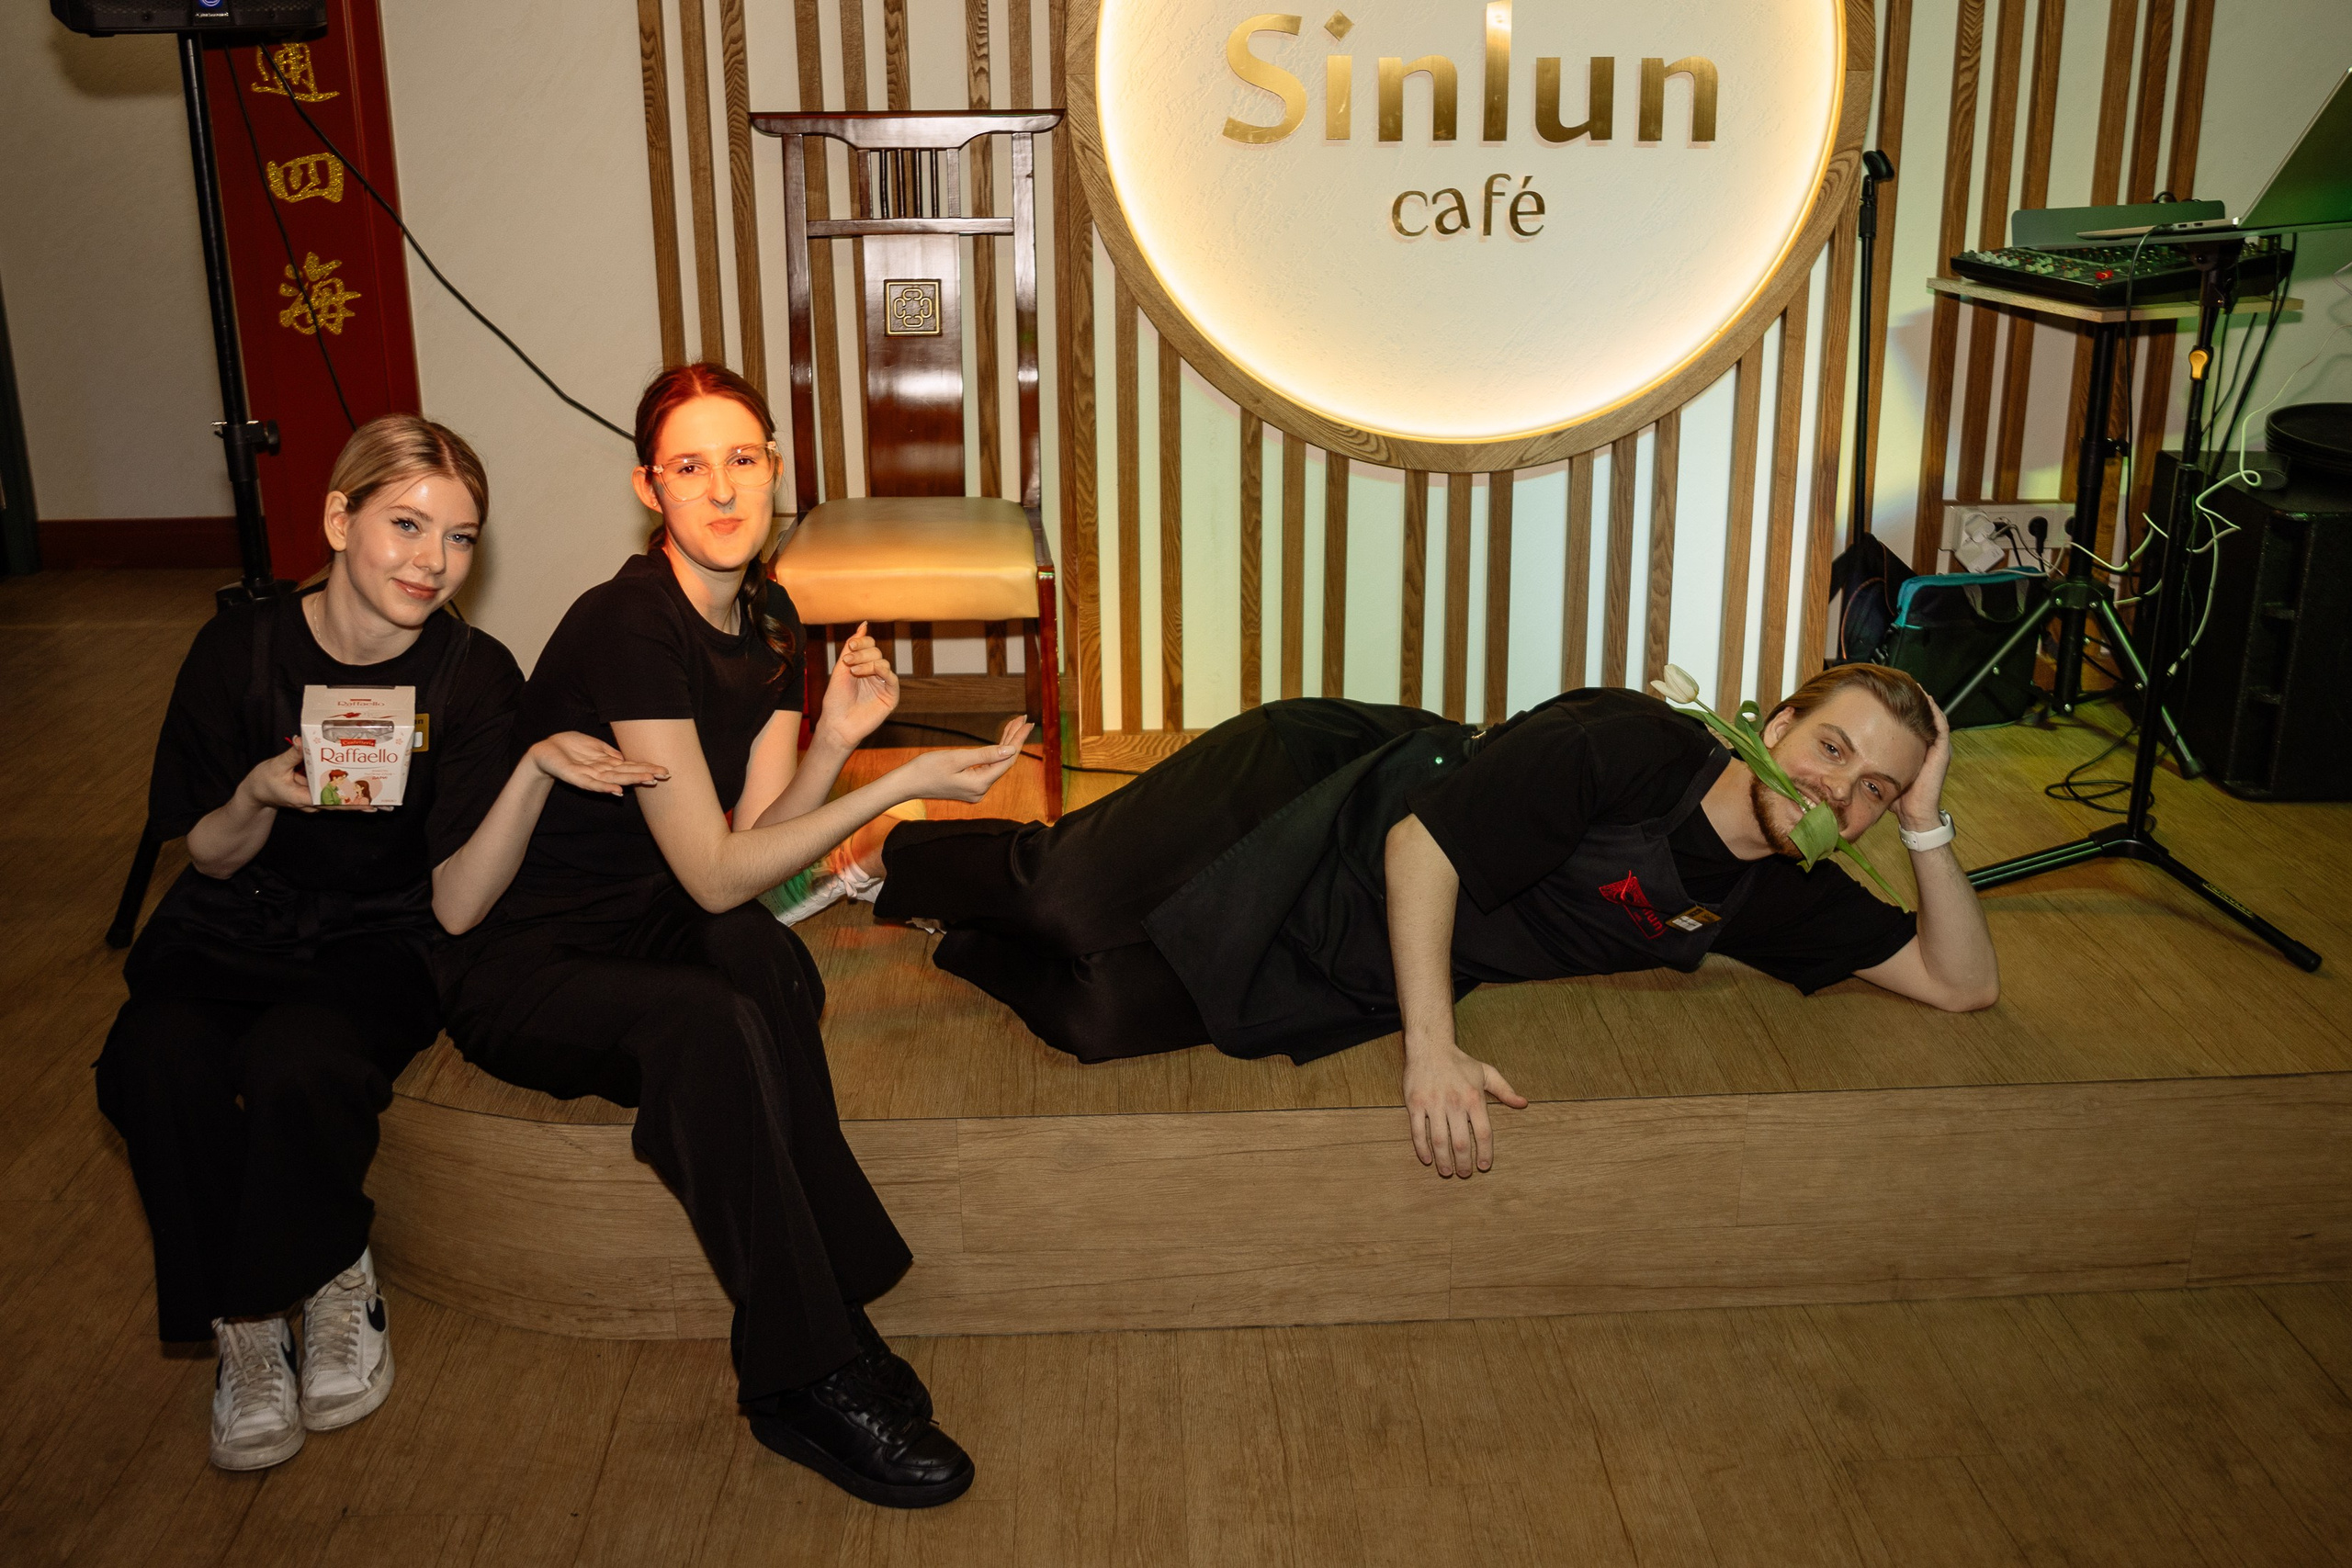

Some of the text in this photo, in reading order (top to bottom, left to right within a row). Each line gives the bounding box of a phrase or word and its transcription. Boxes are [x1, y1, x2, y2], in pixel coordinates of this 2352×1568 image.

[1222, 0, 1718, 143] Sinlun
[1391, 173, 1546, 237] café
[321, 747, 398, 765] Raffaello
